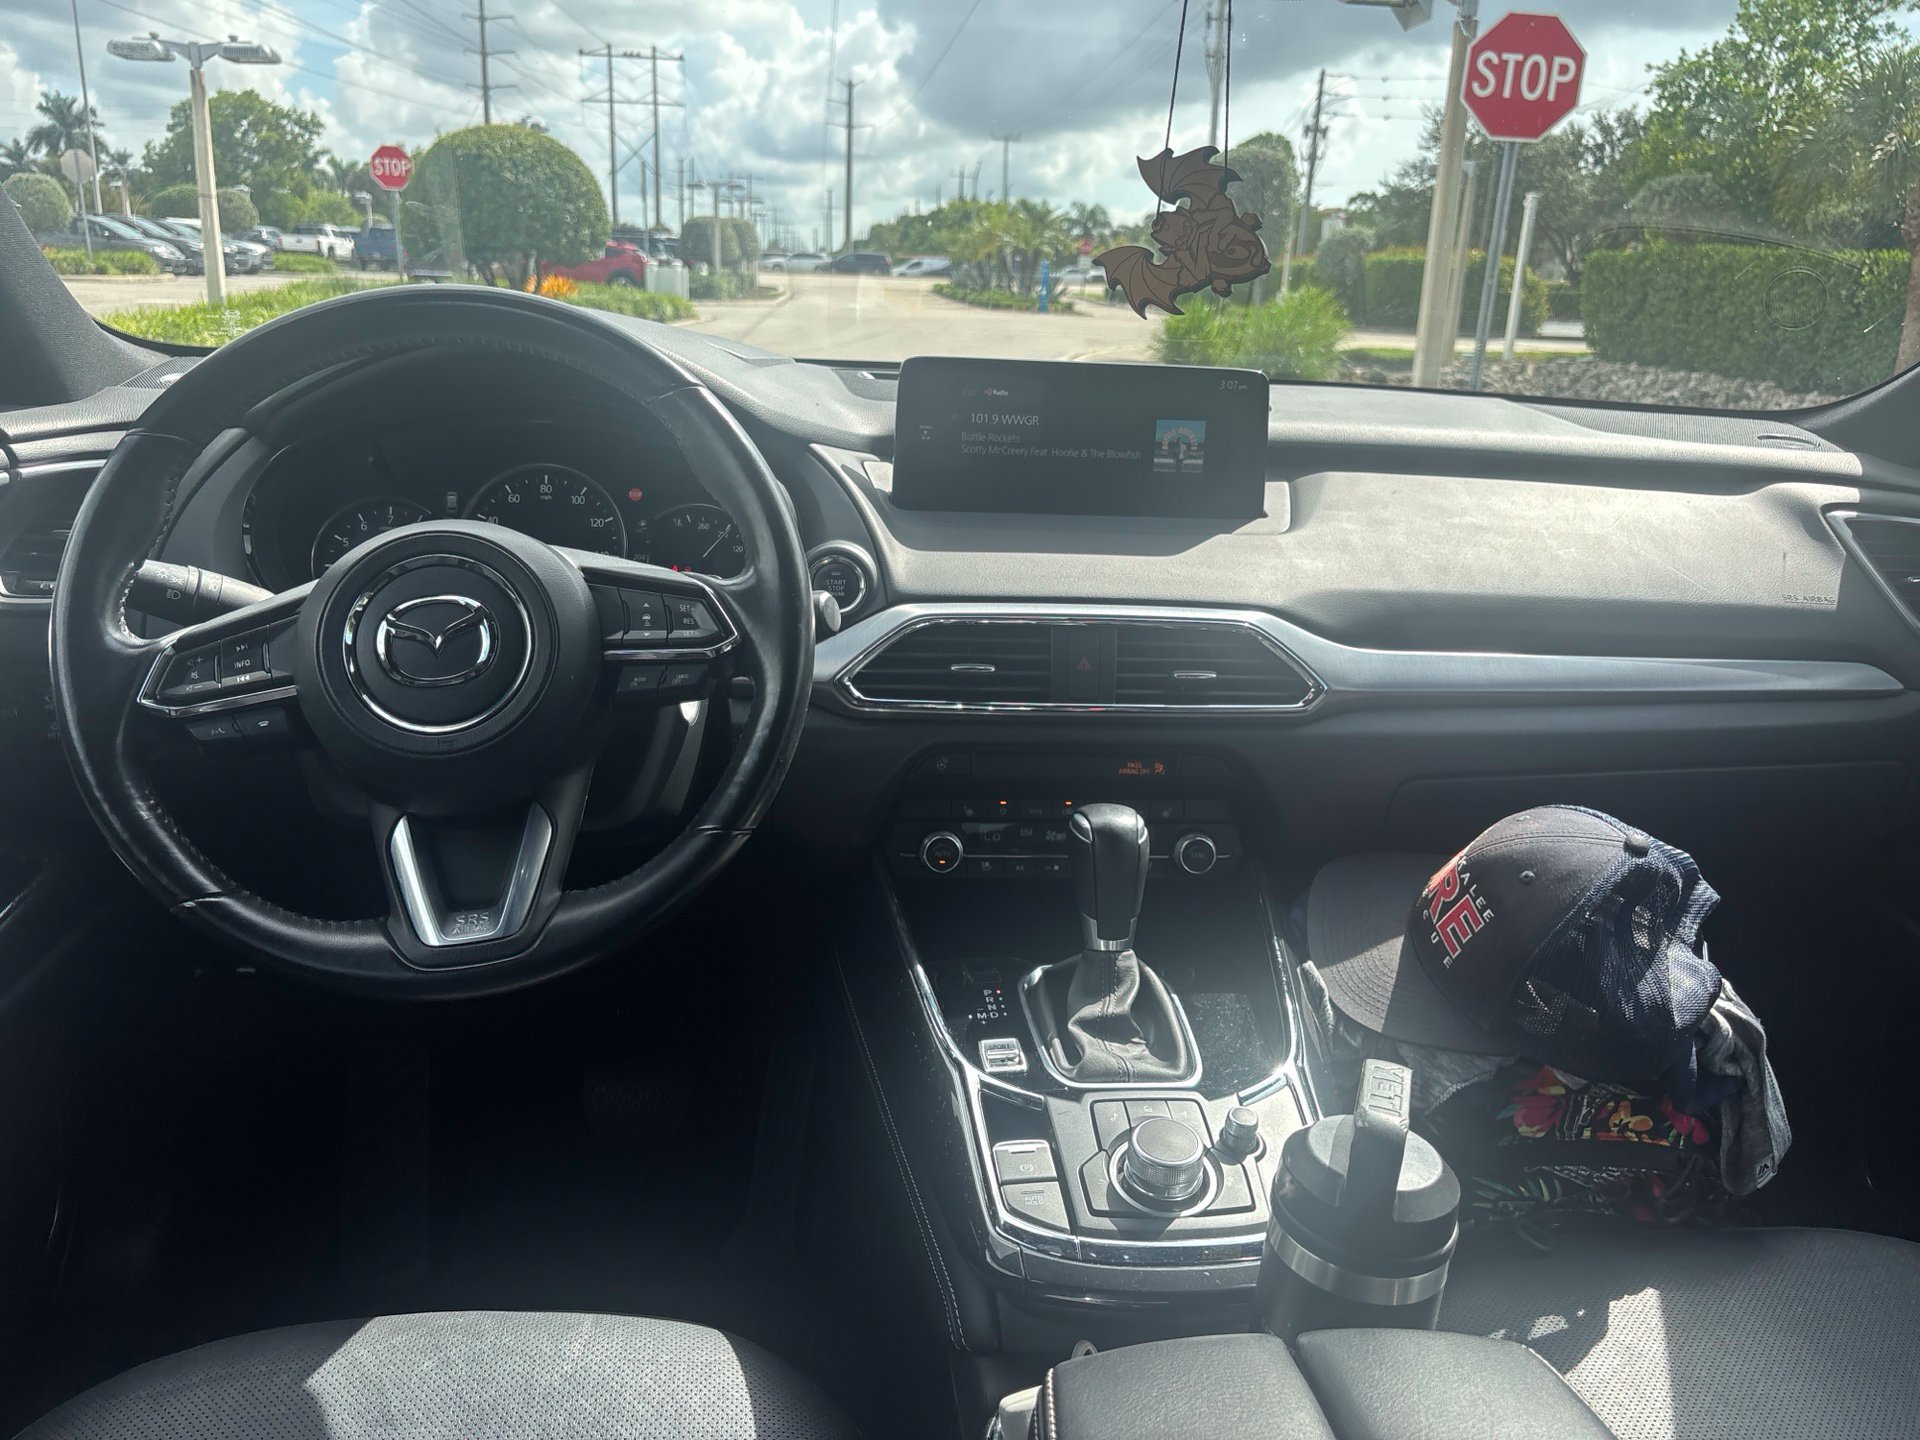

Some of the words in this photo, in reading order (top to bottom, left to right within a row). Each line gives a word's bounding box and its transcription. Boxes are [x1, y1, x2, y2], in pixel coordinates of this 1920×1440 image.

[1471, 50, 1577, 102] STOP
[373, 157, 412, 177] STOP
[971, 412, 999, 424] 101.9
[1001, 414, 1040, 425] WWGR
[961, 431, 986, 442] Bottle
[988, 432, 1020, 444] Rockets
[961, 443, 987, 455] Scotty
[989, 445, 1030, 457] McCreery
[1051, 448, 1079, 458] Hootie
[1080, 448, 1088, 458] &
[1089, 448, 1105, 459] The
[1106, 449, 1142, 460] Blowfish
[540, 484, 553, 494] 80
[508, 494, 520, 503] 60
[571, 495, 586, 505] 100
[387, 515, 394, 524] 7
[590, 518, 604, 528] 120
[360, 522, 368, 531] 6
[342, 537, 349, 547] 5
[1782, 593, 1799, 602] SRS
[1803, 595, 1836, 604] AIRBAG
[683, 617, 695, 625] RES
[234, 659, 251, 669] INFO
[455, 911, 490, 925] SRS
[987, 1003, 997, 1011] N
[976, 1012, 987, 1020] M
[1368, 1066, 1404, 1118] YETI
